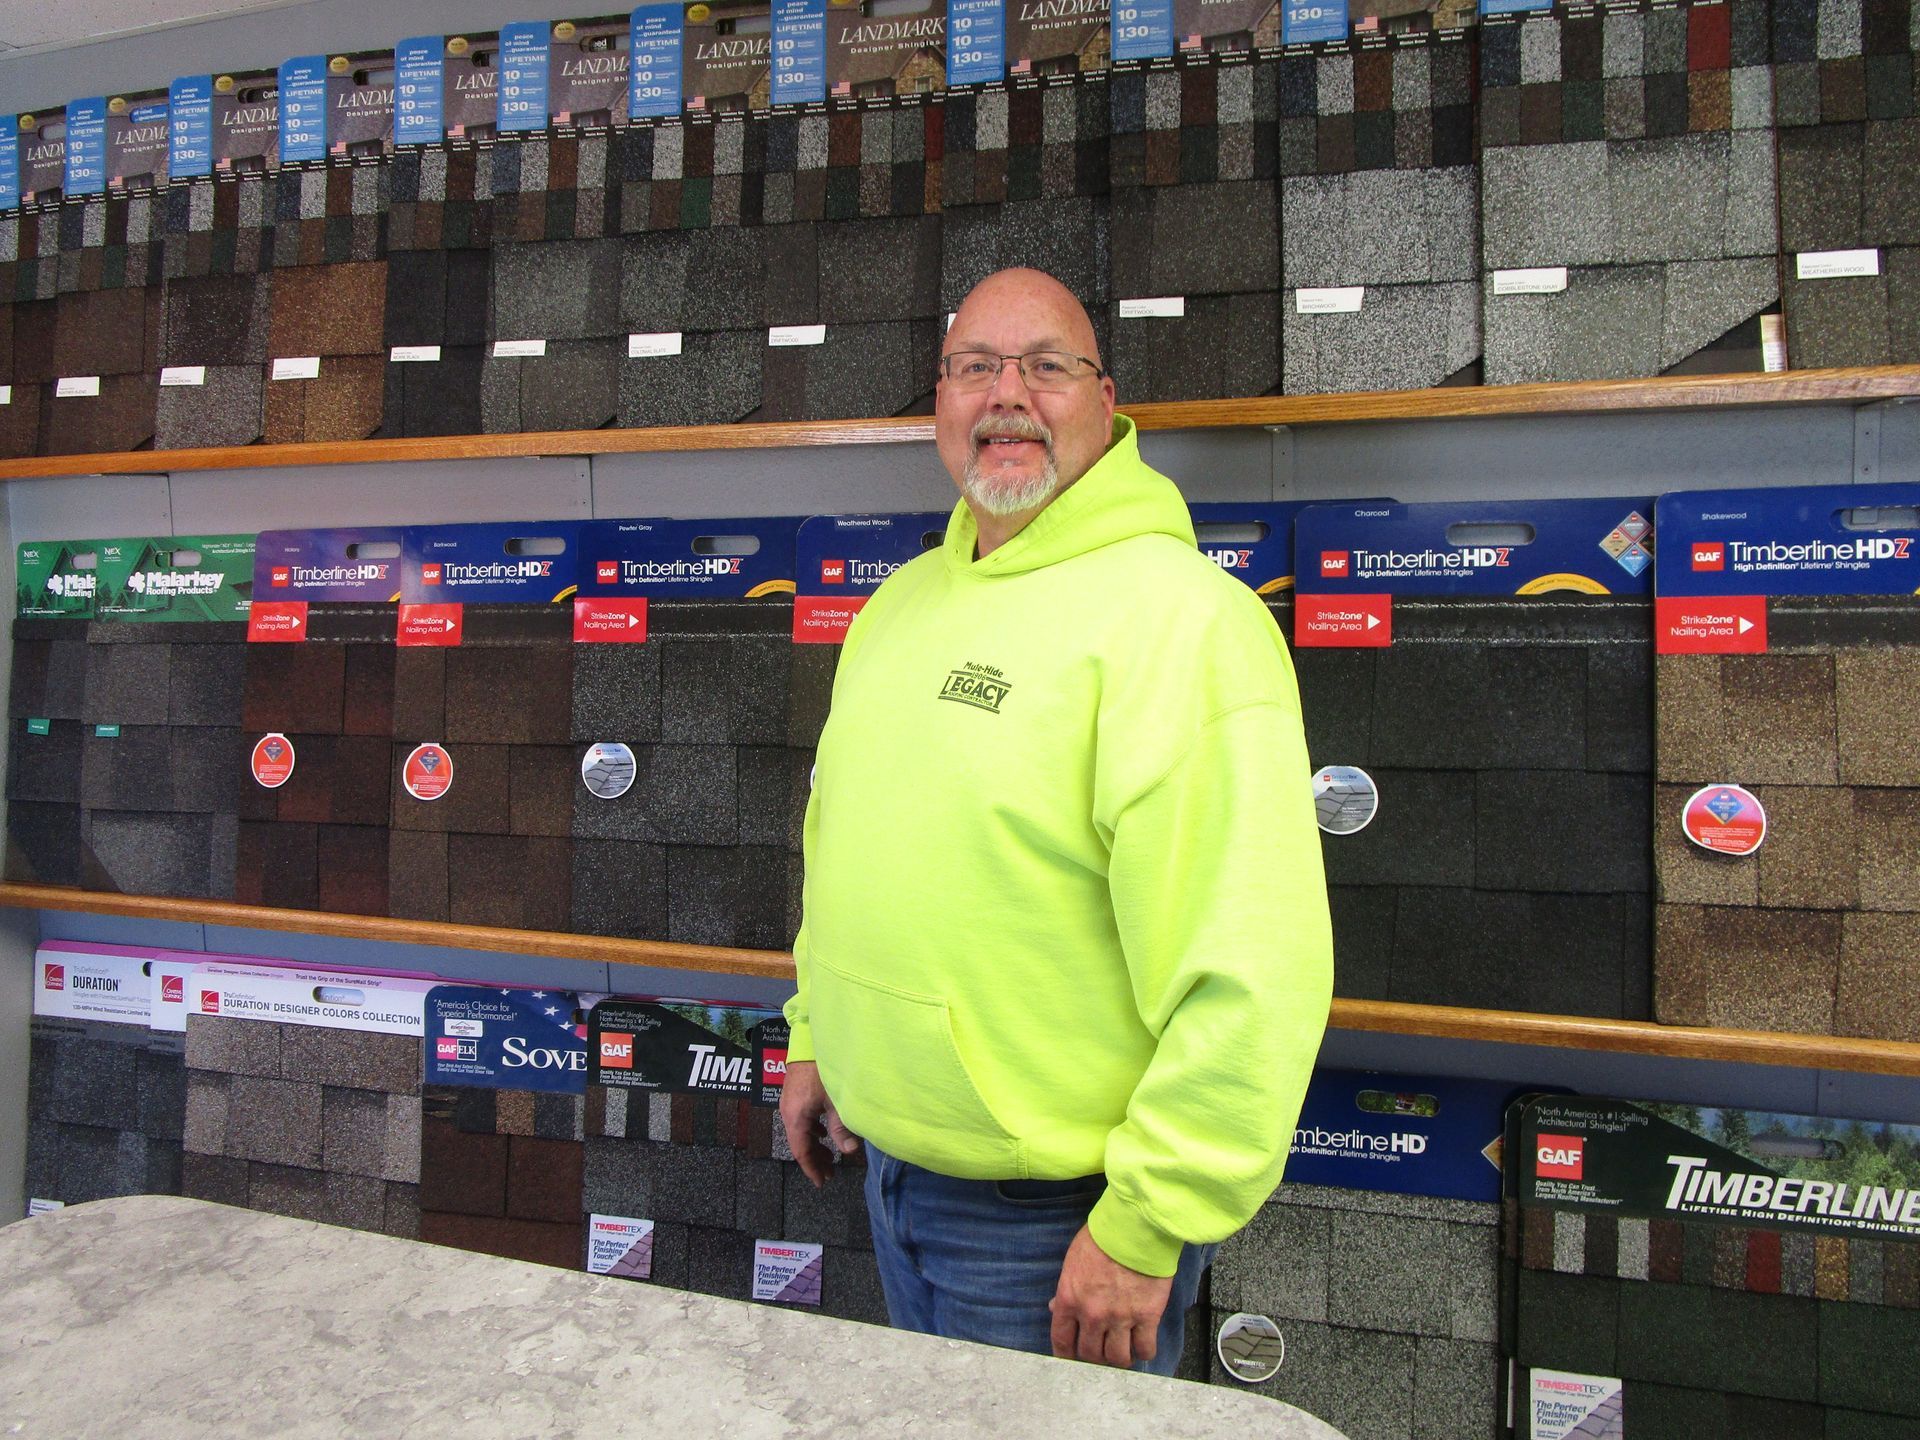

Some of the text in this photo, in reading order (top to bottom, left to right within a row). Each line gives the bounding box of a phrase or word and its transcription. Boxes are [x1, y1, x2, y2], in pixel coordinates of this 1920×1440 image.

[953, 0, 1000, 11] LIFETIME
[1117, 8, 1137, 20] 10
[1288, 7, 1322, 21] 130
[776, 22, 822, 33] LIFETIME
[952, 17, 972, 29] 10
[1031, 20, 1077, 31] Designer
[838, 16, 947, 45] LANDMARK
[1117, 26, 1149, 38] 130
[635, 39, 679, 48] LIFETIME
[776, 39, 794, 51] 10
[850, 39, 941, 54] Designer Shingles
[952, 35, 972, 47] 10
[635, 55, 653, 65] 10
[776, 56, 794, 67] 10
[952, 51, 982, 64] 130
[503, 70, 520, 80] 10
[635, 71, 652, 82] 10
[775, 72, 804, 83] 130
[503, 86, 520, 96] 10
[634, 87, 661, 98] 130
[502, 101, 529, 112] 130
[174, 121, 188, 130] 10
[286, 119, 301, 128] 10
[399, 115, 424, 125] 130
[174, 136, 188, 145] 10
[285, 133, 309, 143] 130
[173, 150, 195, 159] 130
[1701, 512, 1747, 521] Shakewood
[104, 547, 121, 556] NEX
[1694, 551, 1720, 563] GAF
[1323, 559, 1345, 569] GAF
[1734, 561, 1871, 573] High Definition Lifetime Shingles
[423, 570, 439, 578] GAF
[599, 568, 616, 577] GAF
[823, 568, 842, 576] GAF
[1357, 570, 1374, 578] High
[1376, 569, 1411, 577] Definition
[1443, 568, 1474, 577] Shingles
[146, 571, 224, 589] Malarkey
[851, 577, 866, 585] High
[64, 589, 92, 598] Roofing
[146, 586, 214, 596] Roofing Products
[591, 612, 625, 620] StrikeZone
[1317, 612, 1362, 620] StrikeZone
[1681, 614, 1734, 624] StrikeZone
[584, 621, 625, 629] Nailing Area
[803, 619, 829, 628] Nailing
[1308, 622, 1362, 632] Nailing Area
[1671, 626, 1734, 638] Nailing Area
[963, 661, 1004, 678] Mule-Hide
[940, 675, 1010, 709] LEGACY
[72, 975, 119, 992] DURATION
[223, 998, 420, 1025] DURATION DESIGNER COLORS COLLECTION
[471, 1001, 498, 1012] Choice
[500, 1002, 510, 1012] for
[436, 1009, 465, 1018] Superior
[437, 1043, 476, 1055] GAF ELK
[502, 1036, 588, 1072] SOVE
[600, 1043, 632, 1057] GAF
[763, 1059, 787, 1074] GA
[699, 1082, 737, 1091] LIFETIME
[1564, 1108, 1604, 1120] America's
[1537, 1116, 1587, 1128] Architectural
[1391, 1132, 1426, 1155] HD
[1301, 1146, 1401, 1163] Definition Lifetime Shingles
[1537, 1147, 1581, 1166] GAF
[1665, 1155, 1920, 1224] TIMBERLINE
[1681, 1203, 1920, 1234] LIFETIME HIGH DEFINITION SHINGLES
[594, 1222, 642, 1233] TIMBERTEX
[605, 1240, 629, 1249] Perfect
[593, 1245, 623, 1256] Finishing
[759, 1247, 810, 1259] TIMBERTEX
[771, 1265, 796, 1274] Perfect
[758, 1271, 790, 1282] Finishing
[1535, 1379, 1606, 1395] TIMBERTEX
[1553, 1401, 1587, 1413] Perfect
[1536, 1409, 1579, 1422] Finishing
